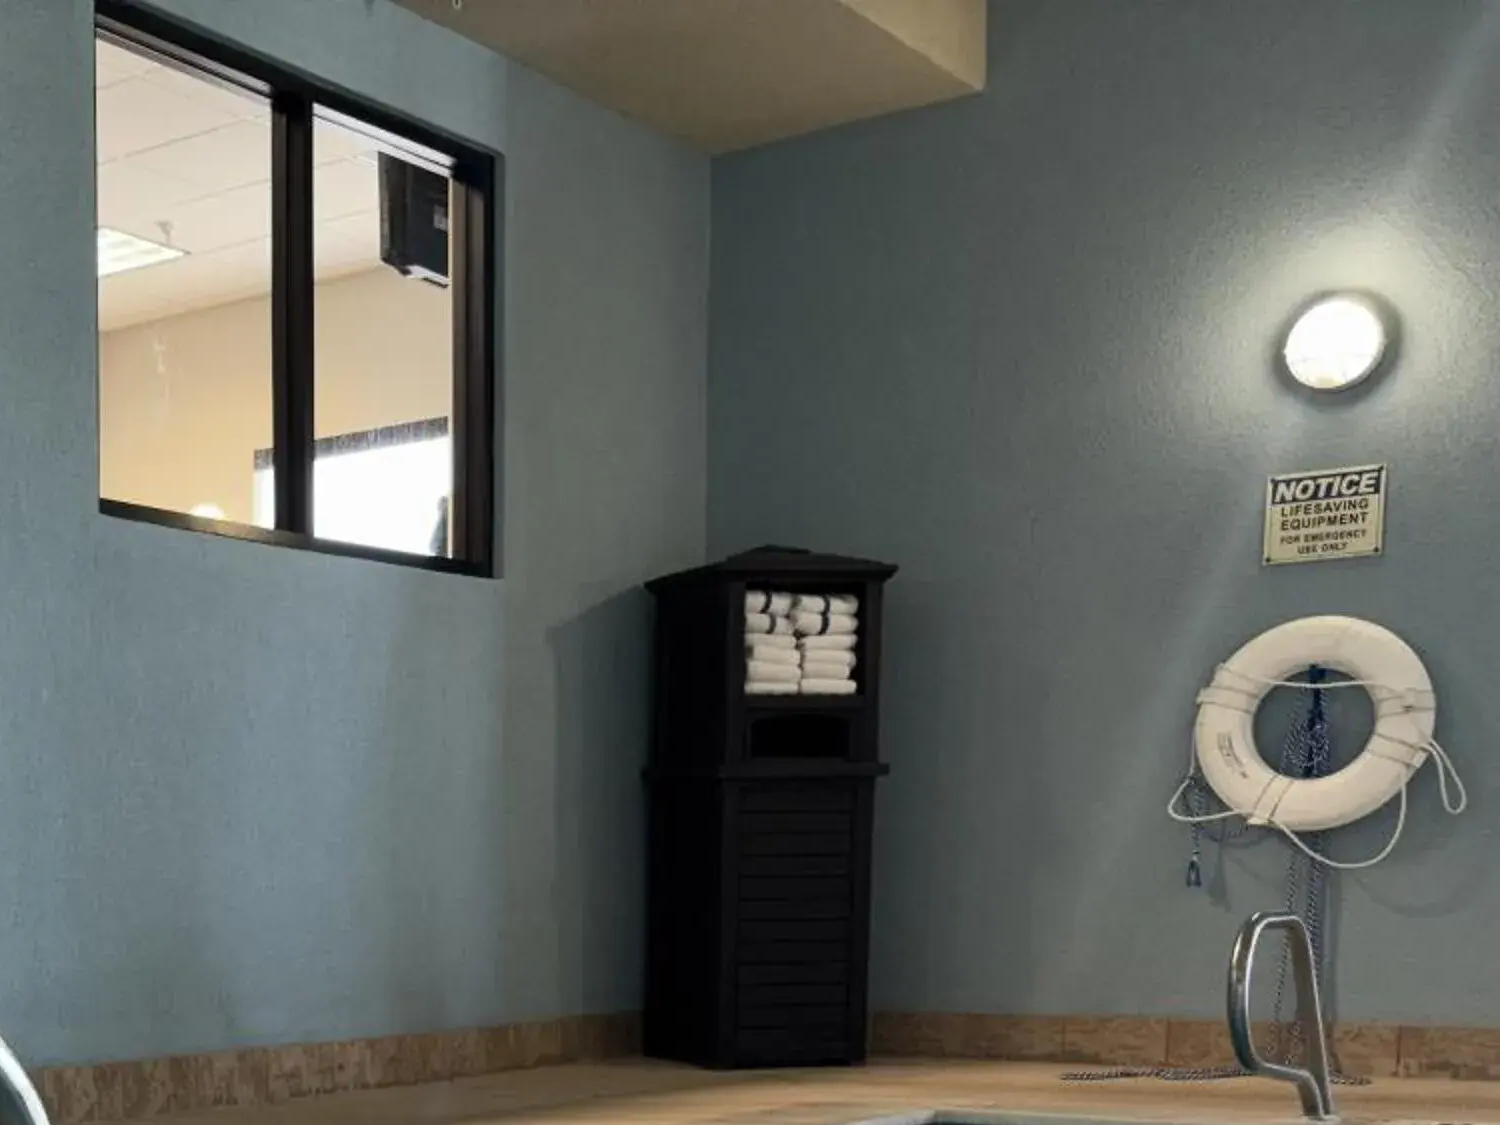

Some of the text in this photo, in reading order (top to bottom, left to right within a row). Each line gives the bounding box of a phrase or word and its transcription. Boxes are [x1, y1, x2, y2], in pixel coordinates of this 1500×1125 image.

[1273, 472, 1379, 503] NOTICE
[1280, 498, 1369, 518] LIFESAVING
[1280, 511, 1369, 531] EQUIPMENT
[1279, 529, 1367, 545] FOR EMERGENCY
[1297, 541, 1349, 555] USE ONLY
